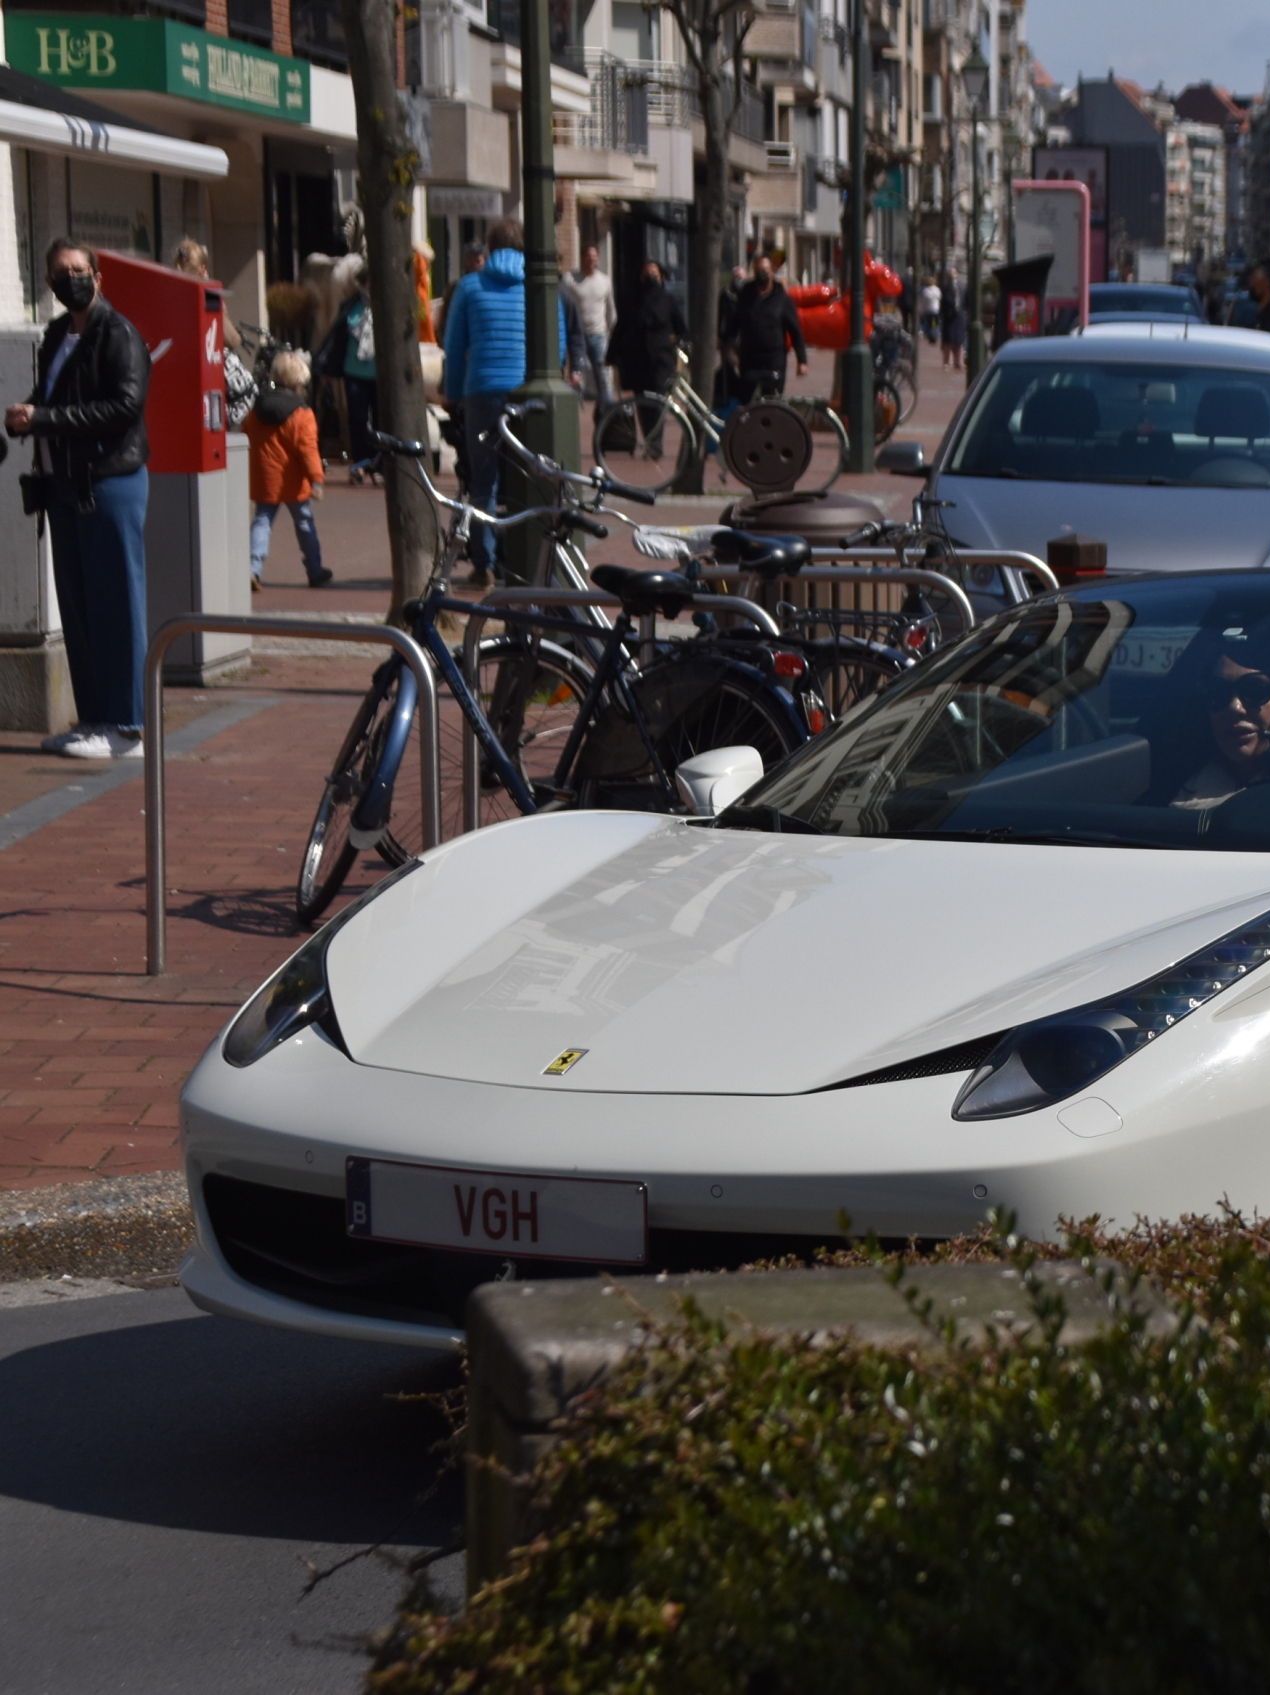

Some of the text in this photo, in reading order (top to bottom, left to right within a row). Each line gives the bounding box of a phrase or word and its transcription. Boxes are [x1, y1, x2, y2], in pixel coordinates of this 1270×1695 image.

[35, 27, 117, 77] H&B
[353, 1201, 368, 1225] B
[454, 1184, 539, 1243] VGH
